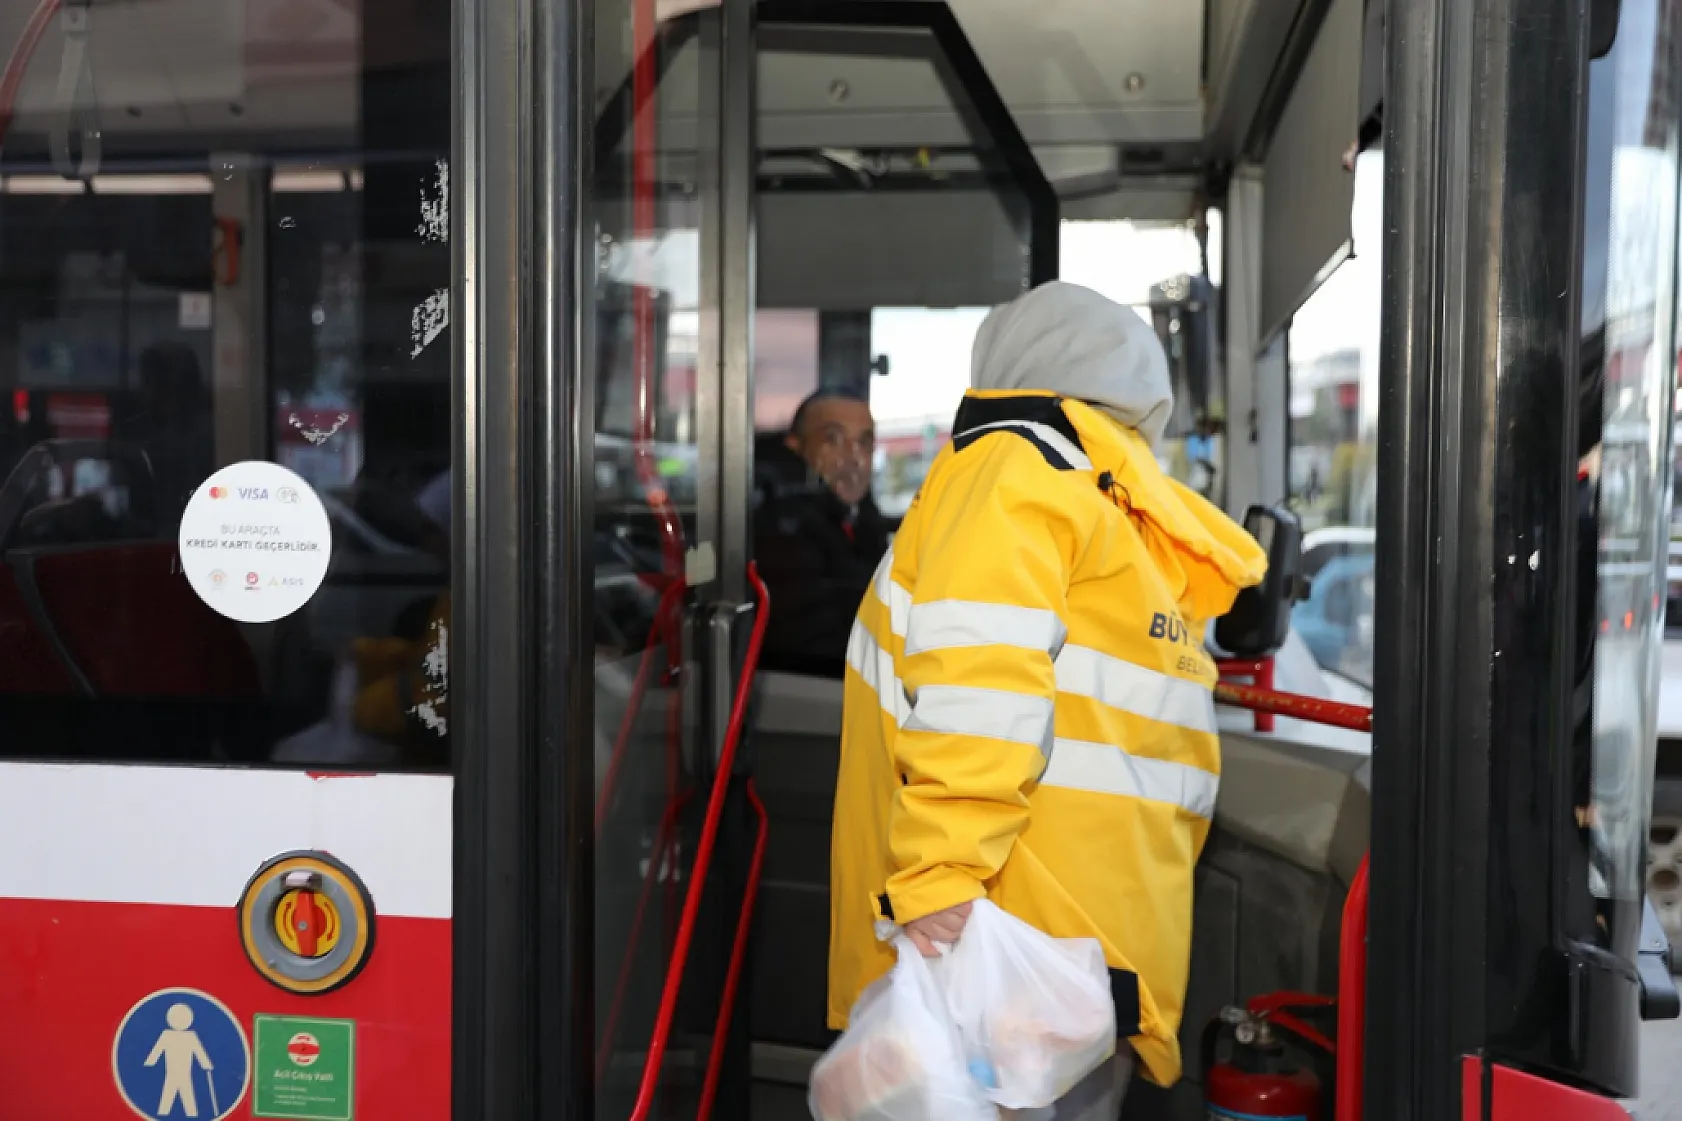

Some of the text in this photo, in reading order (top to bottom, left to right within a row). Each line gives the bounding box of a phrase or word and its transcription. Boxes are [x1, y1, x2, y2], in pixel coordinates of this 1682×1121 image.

[238, 488, 269, 501] VISA
[221, 524, 280, 537] BU ARAÇTA
[186, 538, 218, 549] KREDİ
[221, 540, 252, 550] KARTI
